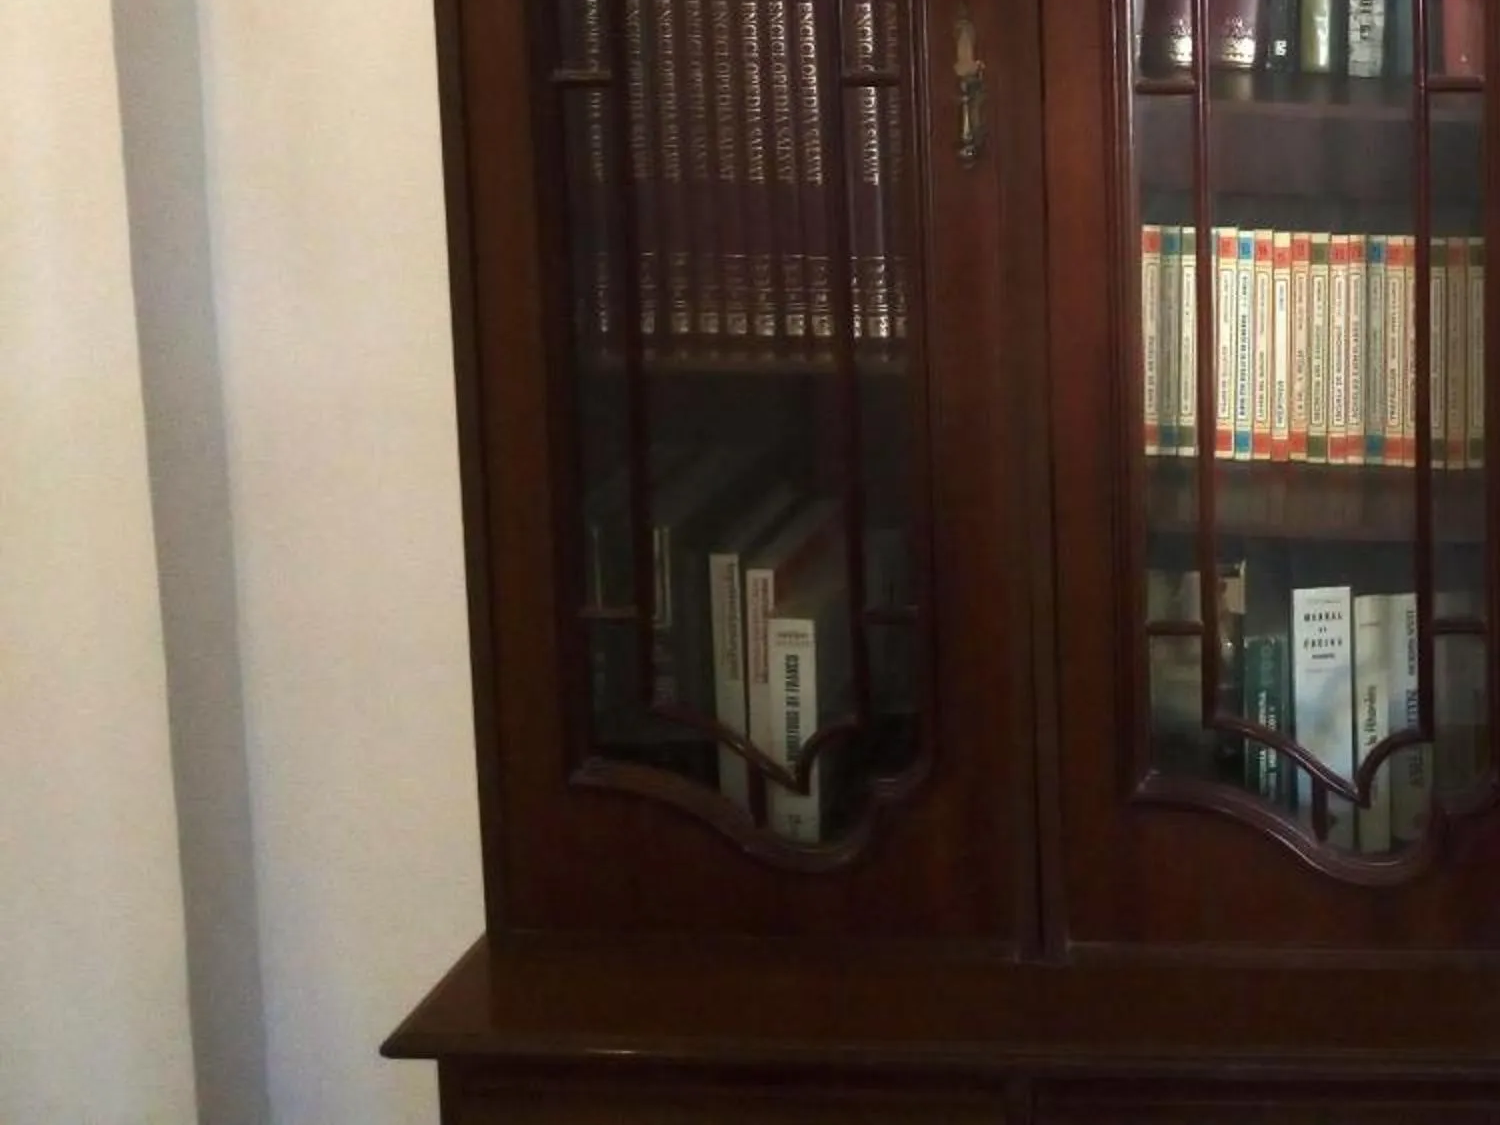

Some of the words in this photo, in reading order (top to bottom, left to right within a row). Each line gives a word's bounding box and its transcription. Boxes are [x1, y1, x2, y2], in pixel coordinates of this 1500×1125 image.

[768, 0, 789, 123] ENCICLOPEDIA
[797, 1, 819, 124] ENCICLOPEDIA
[855, 1, 878, 123] ENCICLOEDIA
